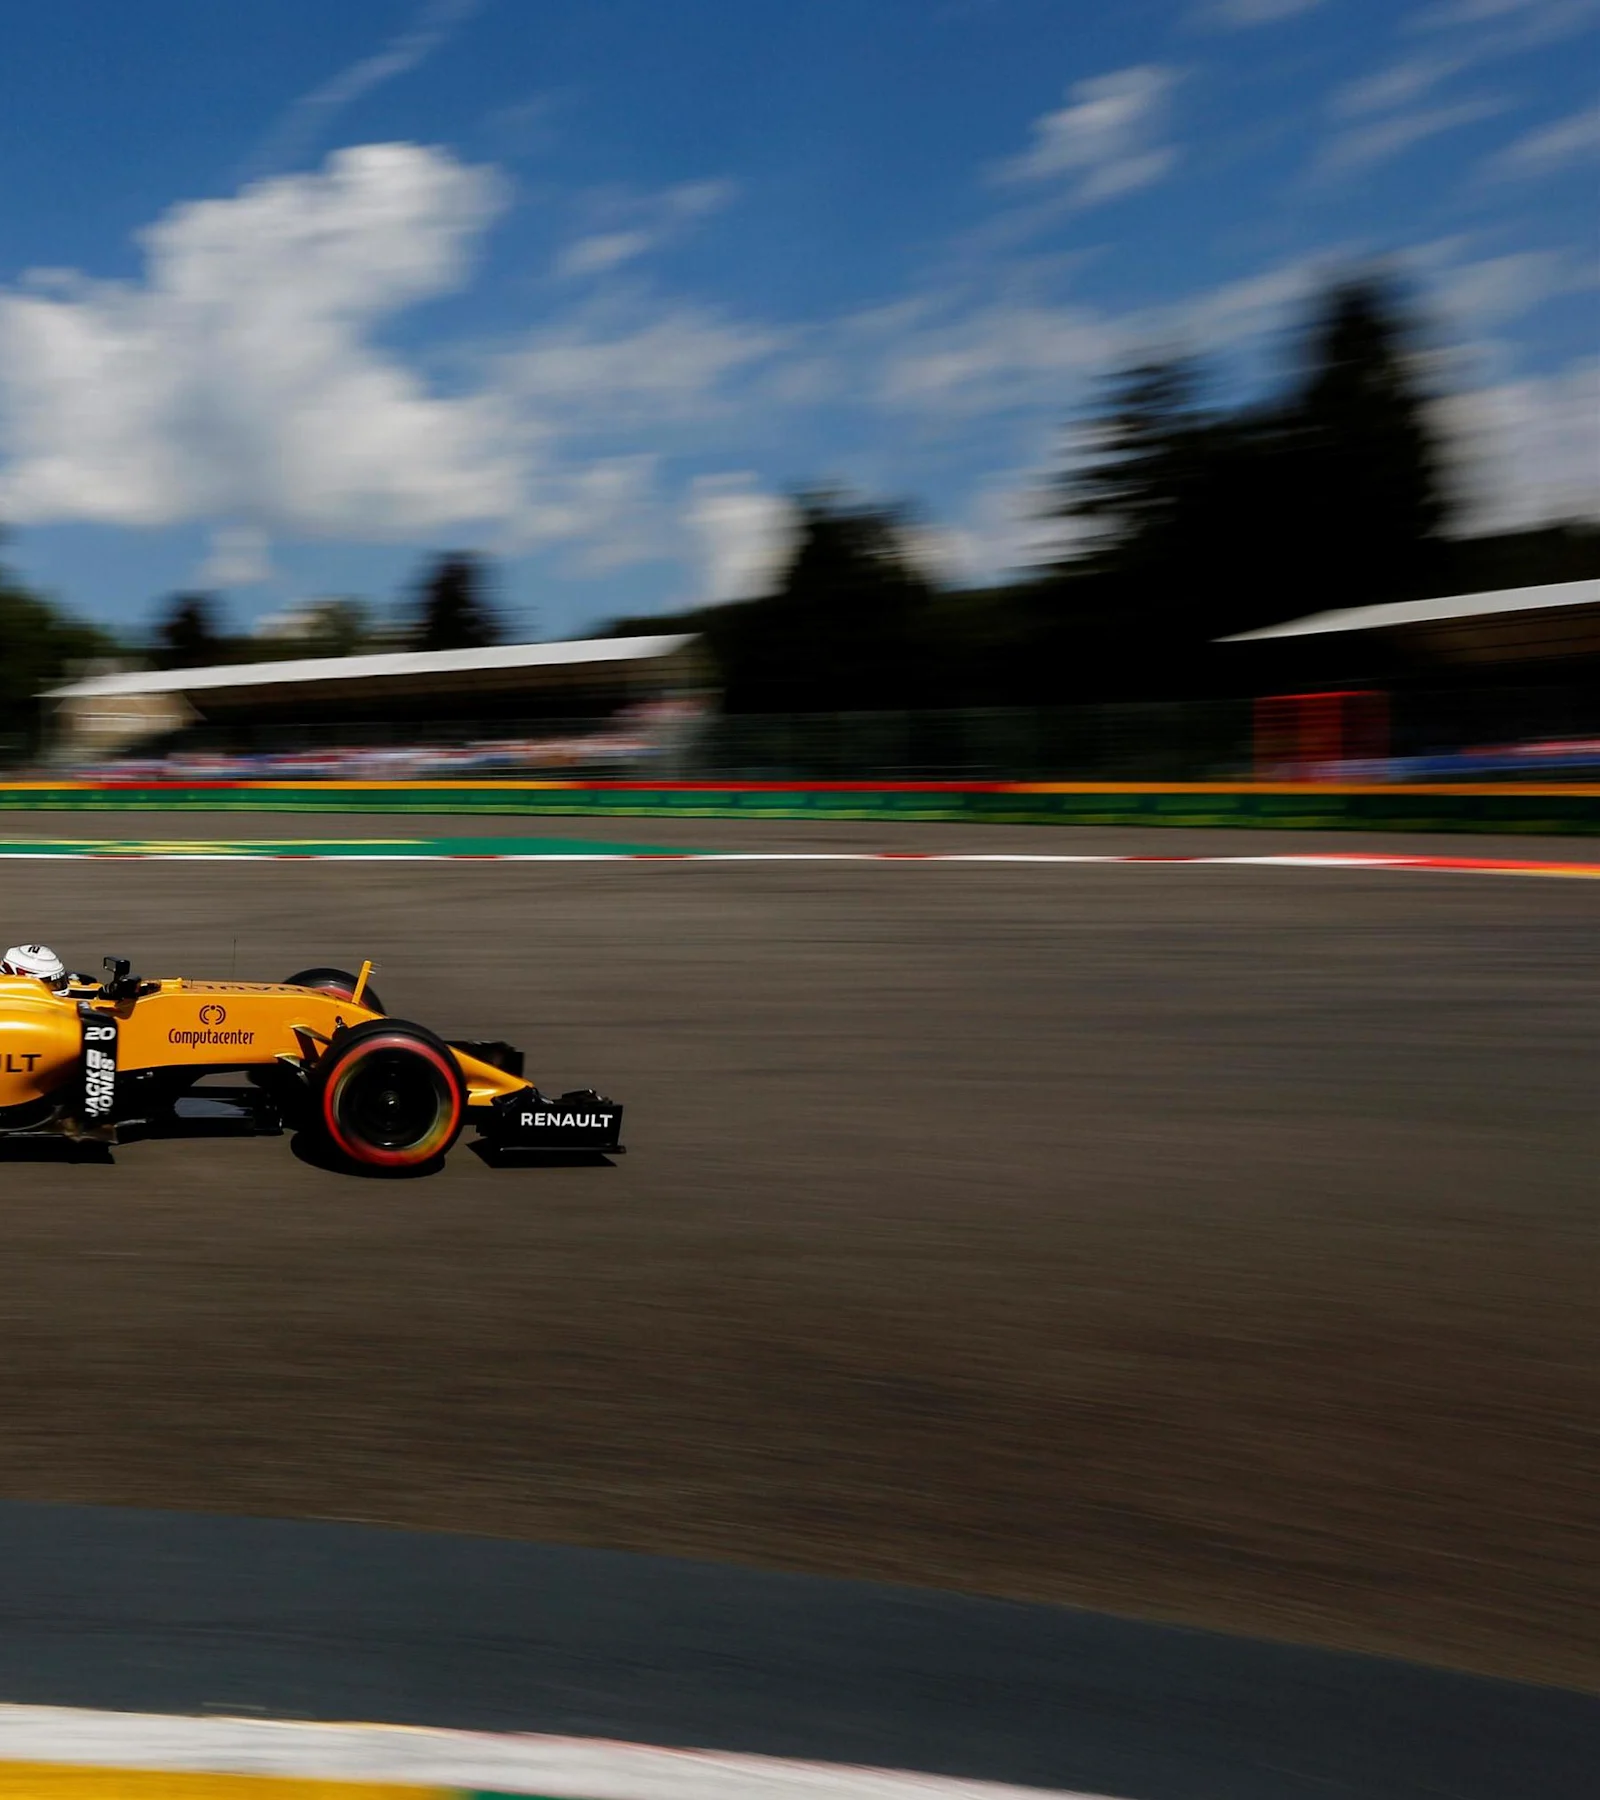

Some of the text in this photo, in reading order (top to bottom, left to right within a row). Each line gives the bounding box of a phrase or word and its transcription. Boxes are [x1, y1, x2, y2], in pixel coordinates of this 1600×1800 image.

[84, 1026, 117, 1041] 20
[168, 1027, 255, 1050] Computacenter
[84, 1069, 101, 1118] JACK
[520, 1111, 614, 1129] RENAULT
